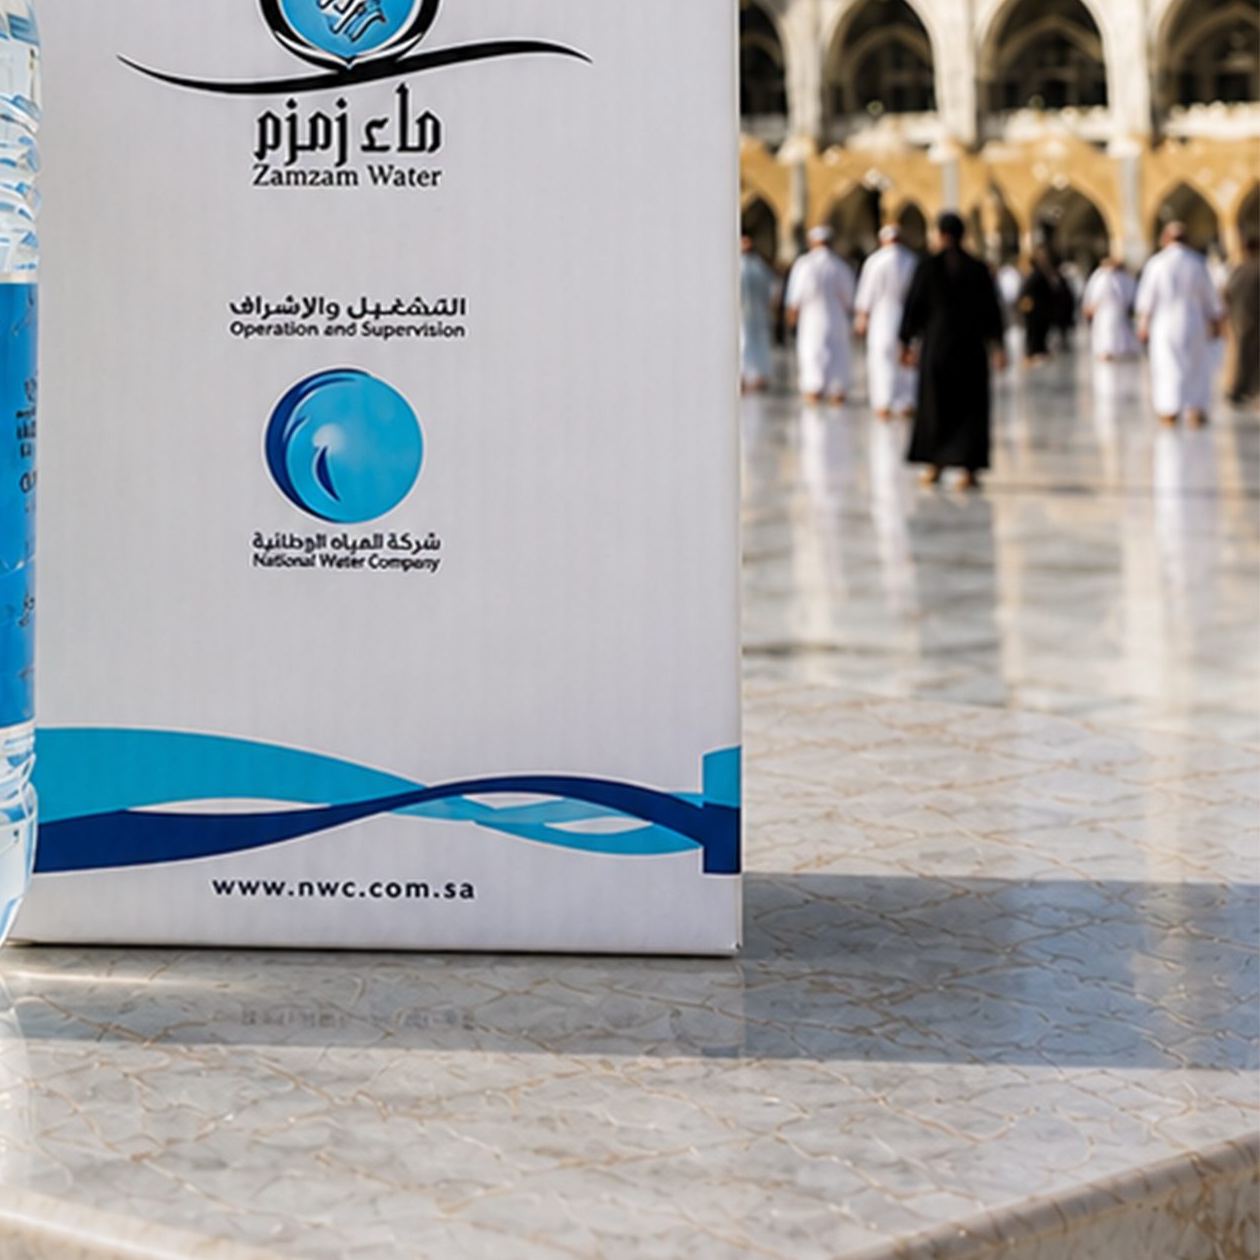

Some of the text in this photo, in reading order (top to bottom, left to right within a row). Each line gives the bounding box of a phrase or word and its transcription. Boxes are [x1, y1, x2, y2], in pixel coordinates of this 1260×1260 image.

[253, 163, 442, 187] Zamzam Water
[229, 320, 465, 341] Operation and Supervision
[253, 551, 316, 568] National
[367, 551, 441, 573] Company
[212, 880, 474, 899] www.nwc.com.sa
